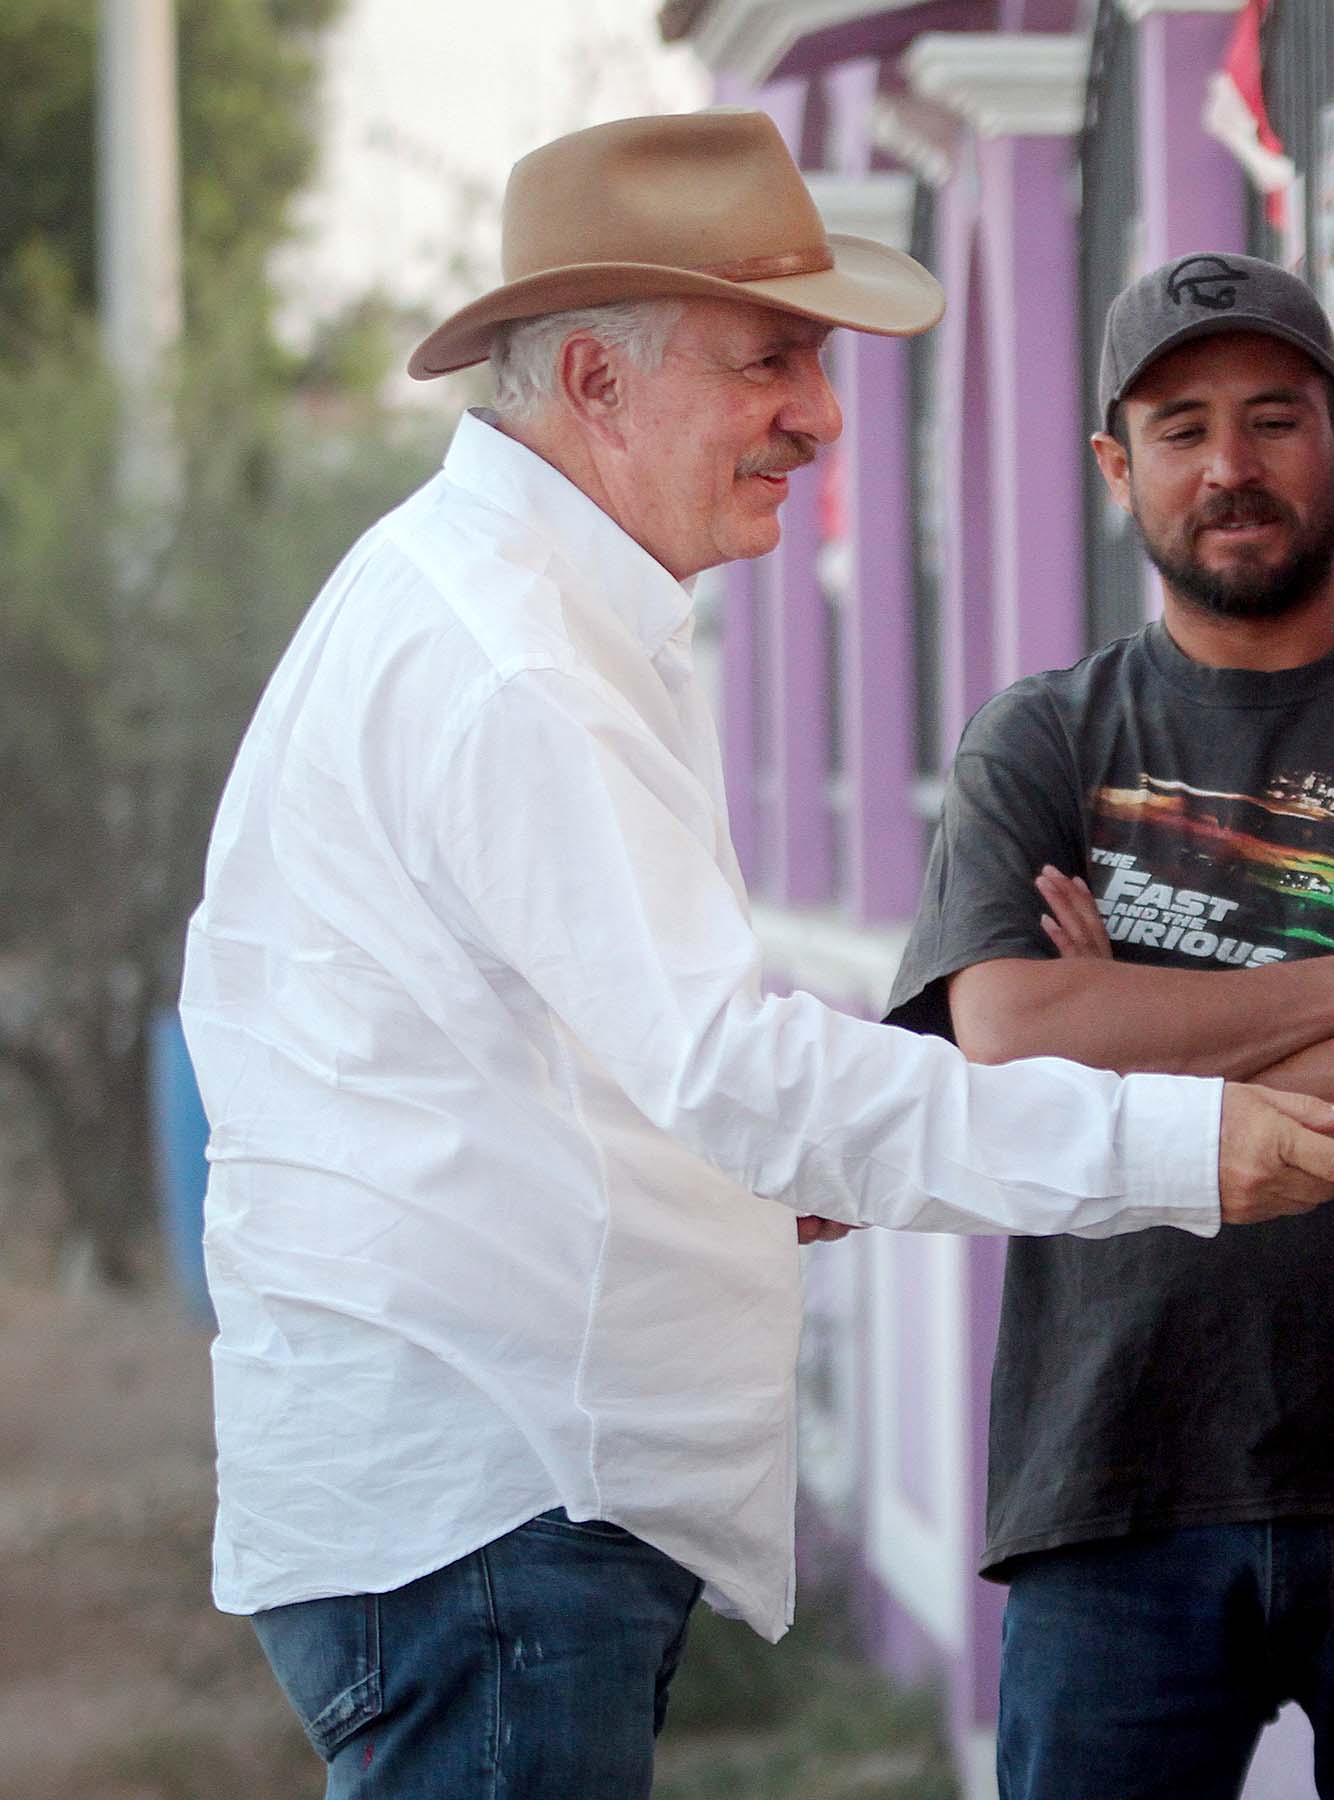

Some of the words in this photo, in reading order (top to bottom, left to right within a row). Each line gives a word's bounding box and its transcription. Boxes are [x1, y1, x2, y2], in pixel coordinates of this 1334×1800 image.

[1091, 848, 1137, 869] THE
[1104, 868, 1239, 922] FAST
[1112, 903, 1159, 921] AND
[1162, 912, 1208, 930] THE
